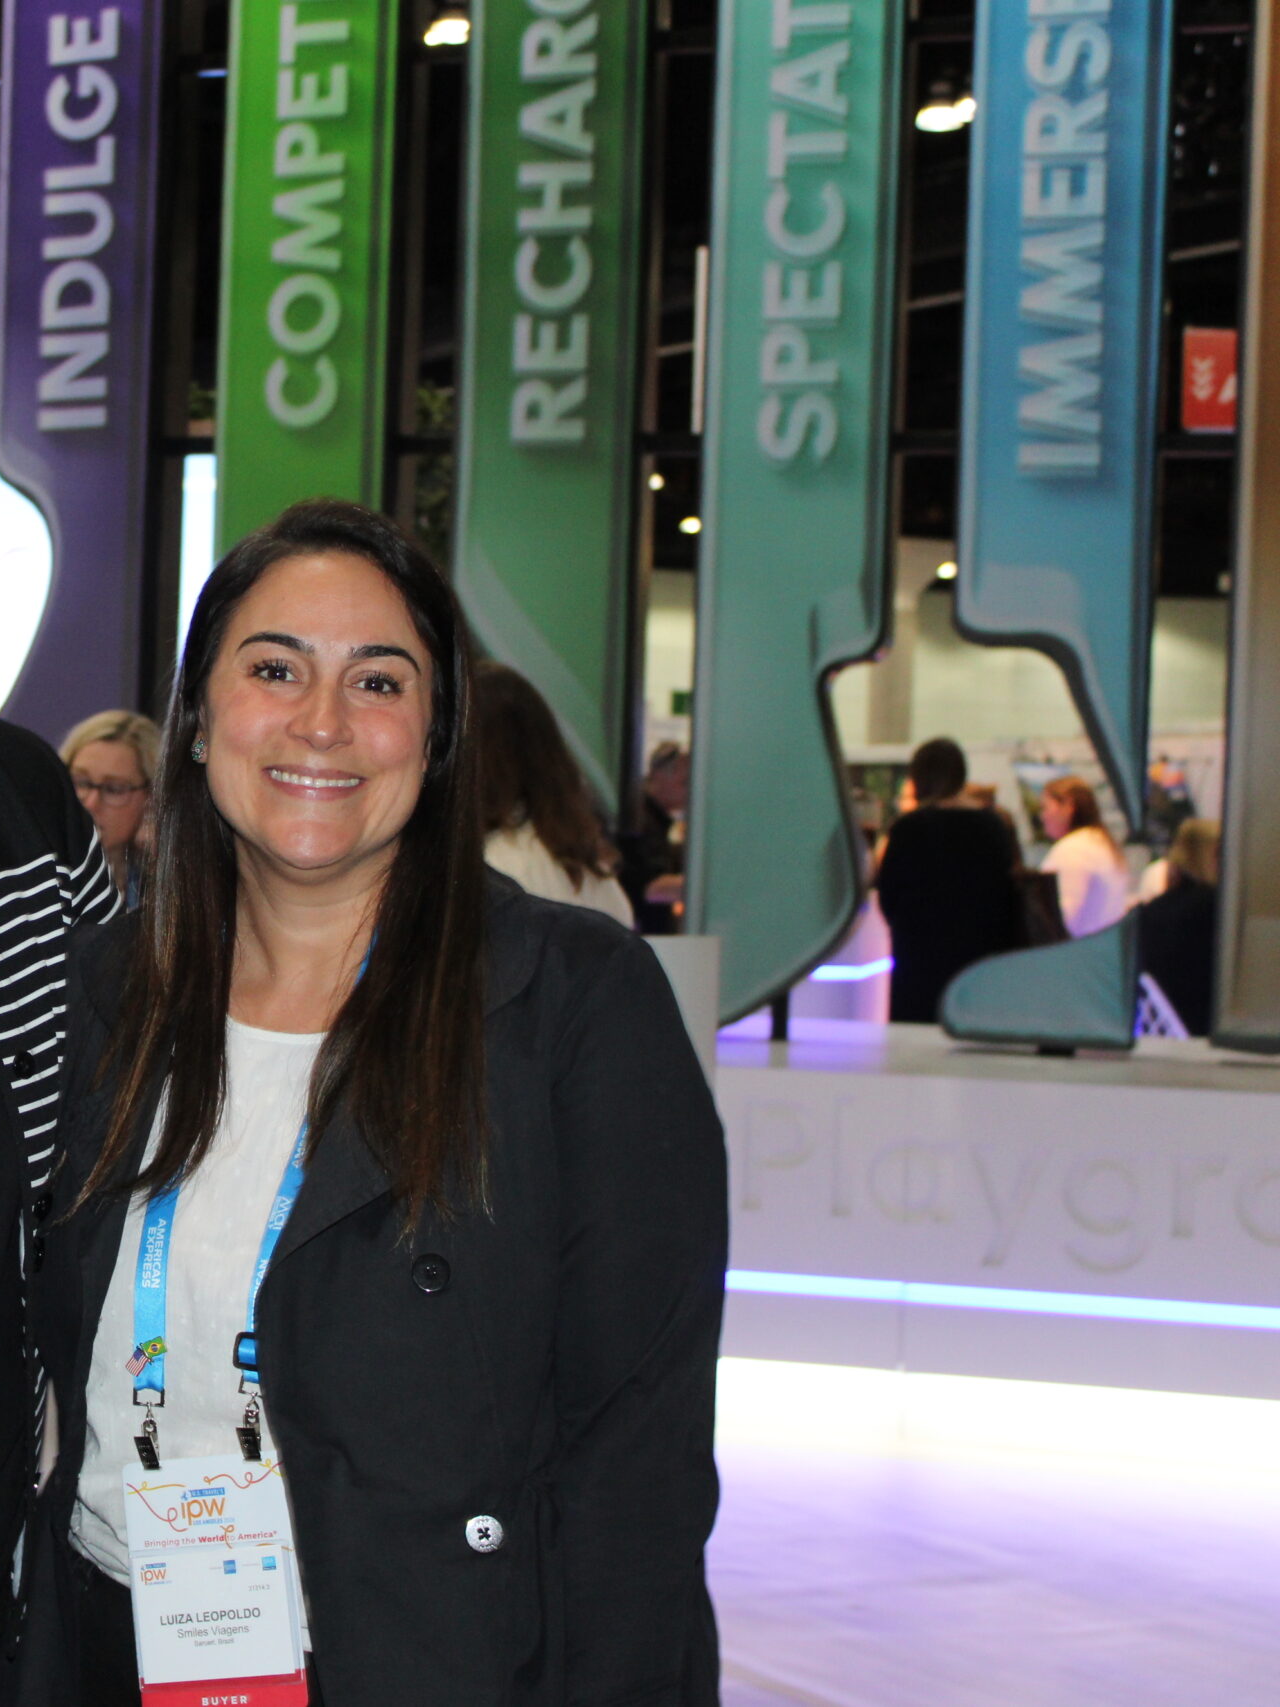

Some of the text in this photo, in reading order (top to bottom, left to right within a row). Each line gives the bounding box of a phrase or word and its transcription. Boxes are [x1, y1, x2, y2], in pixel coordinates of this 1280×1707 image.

[36, 5, 120, 431] INDULGE
[265, 4, 350, 428] COMPET
[756, 0, 851, 468] SPECTAT
[1017, 0, 1111, 474] IMMERS
[141, 1227, 157, 1288] EXPRESS
[150, 1218, 166, 1288] AMERICAN
[181, 1497, 226, 1526] ipw
[144, 1538, 180, 1548] Bringing
[198, 1534, 224, 1543] World
[140, 1568, 167, 1585] ipw
[160, 1607, 261, 1626] LUIZA LEOPOLDO
[177, 1625, 250, 1639] Smiles Viagens
[202, 1696, 248, 1706] BUYER
